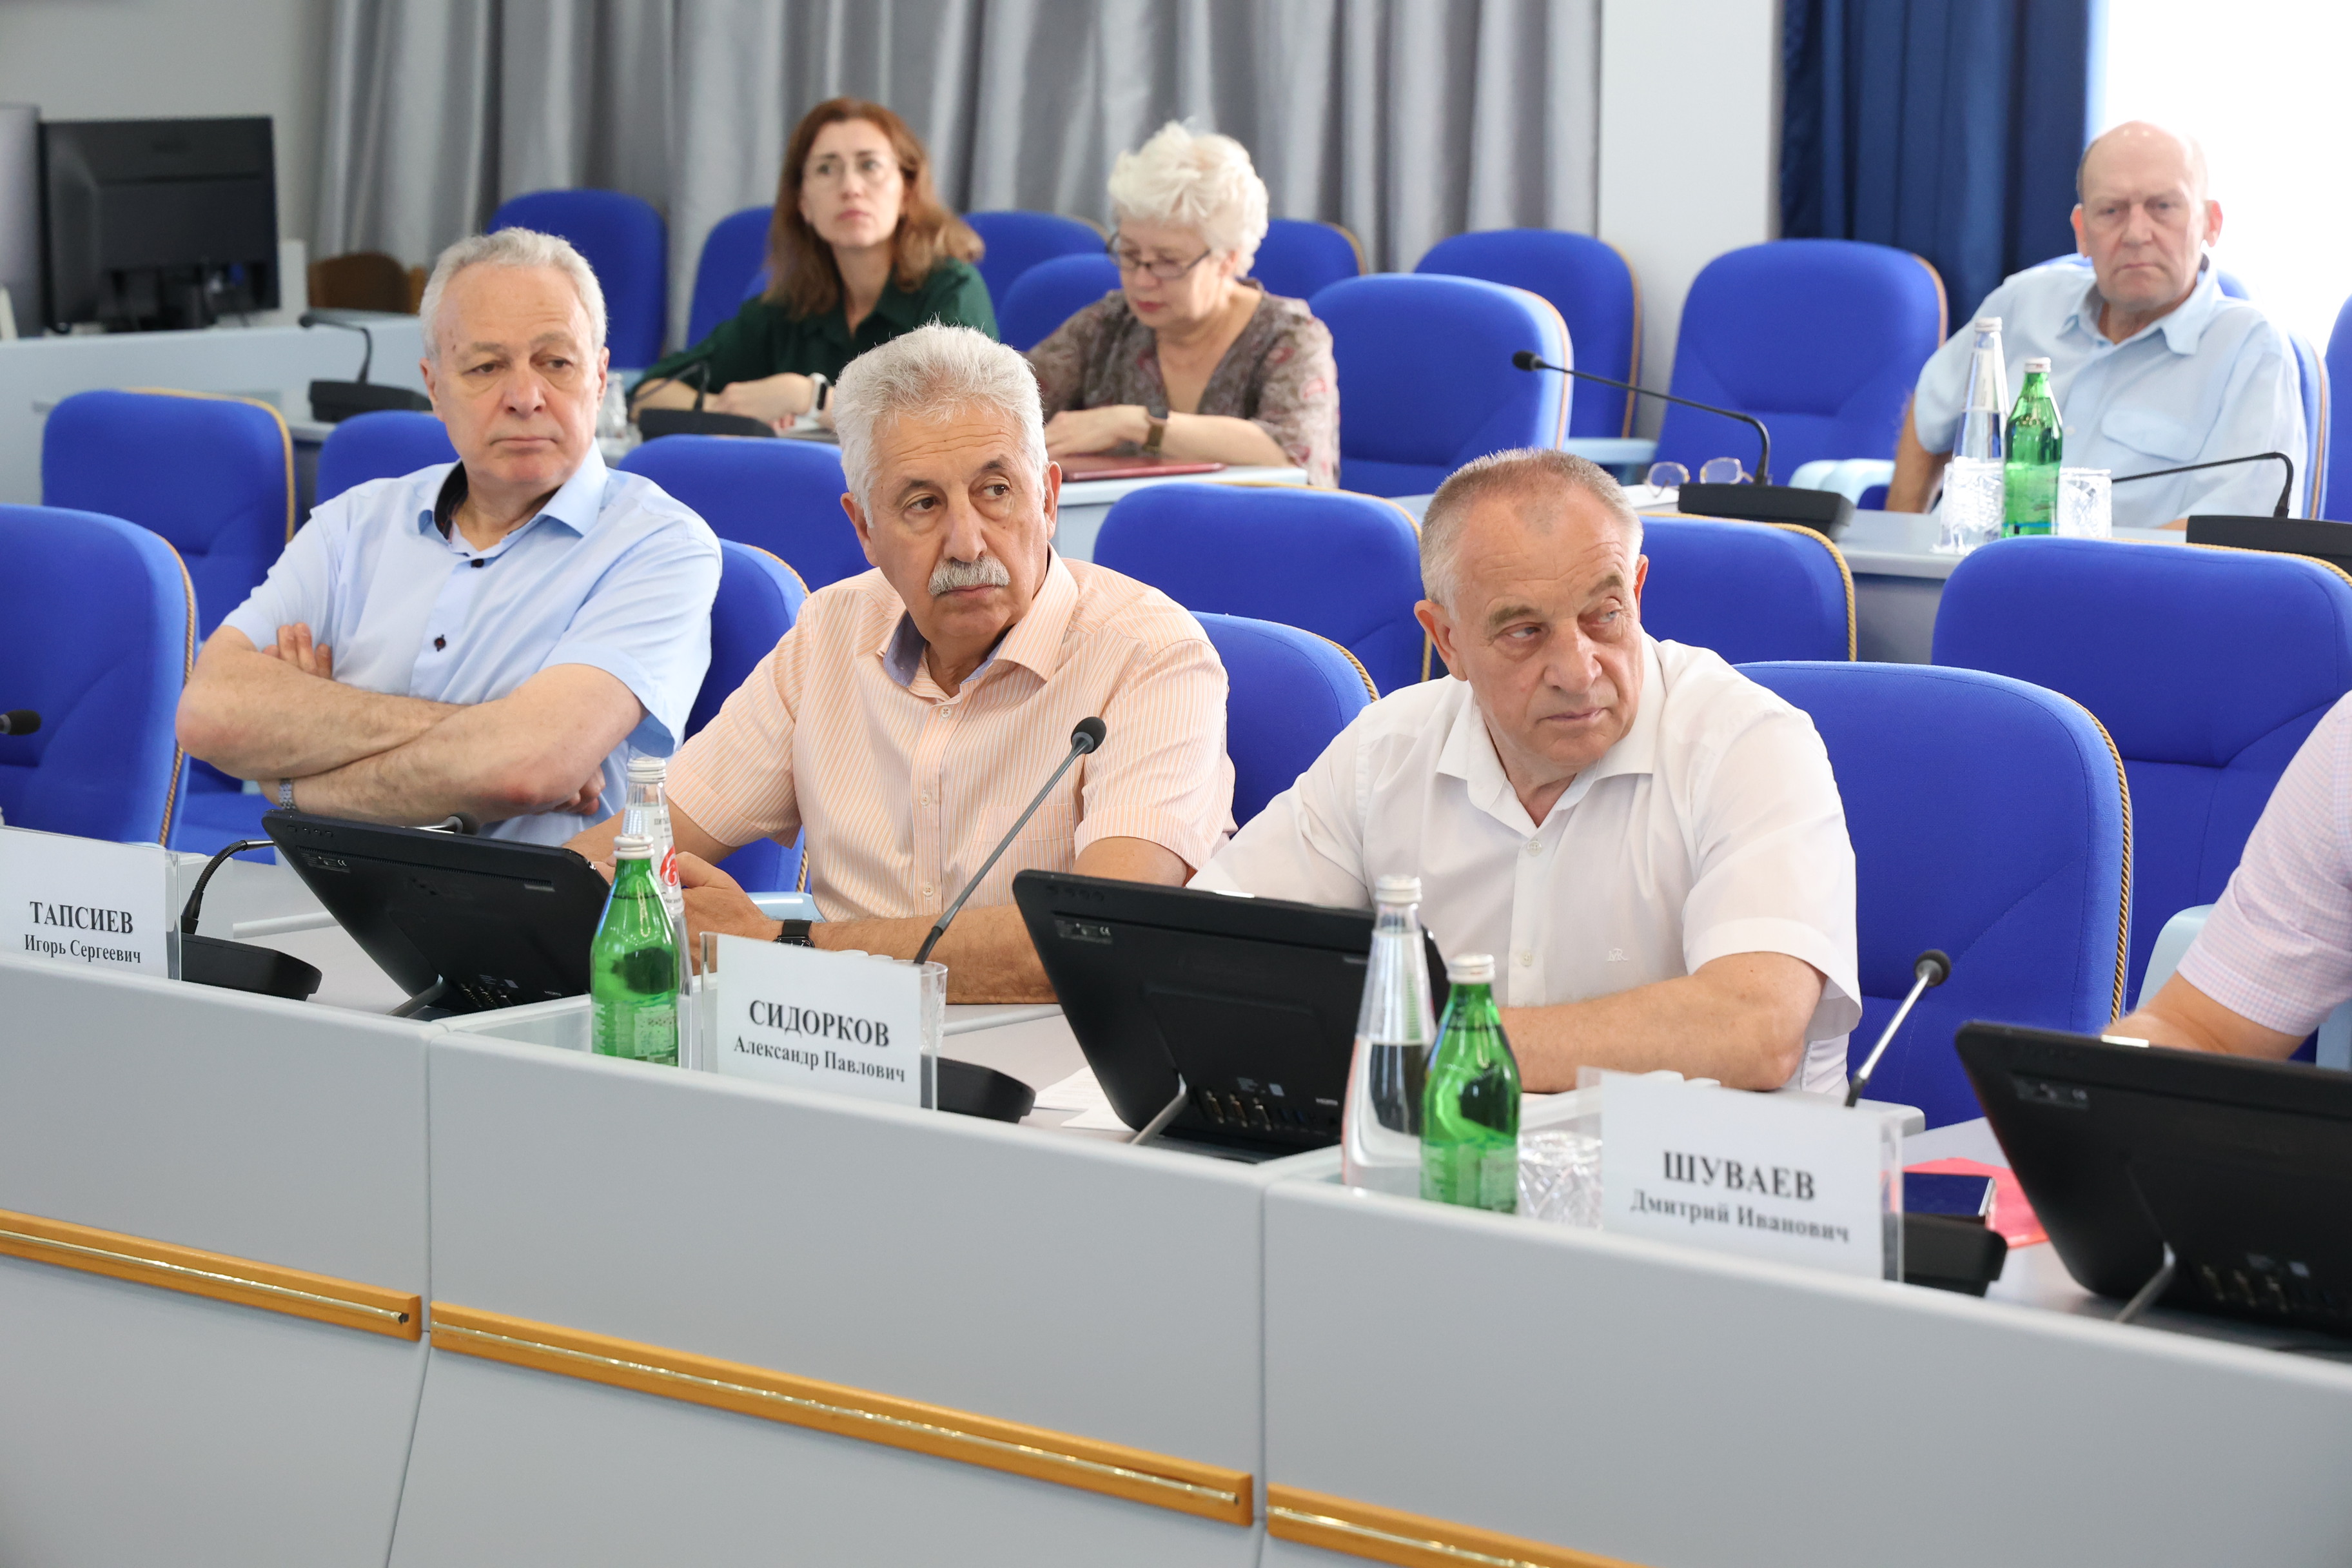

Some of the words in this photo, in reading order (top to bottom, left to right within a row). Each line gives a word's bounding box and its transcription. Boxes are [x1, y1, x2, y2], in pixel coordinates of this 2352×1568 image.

[29, 901, 133, 934] ТАПСИЕВ
[24, 934, 66, 958] Игорь
[70, 939, 141, 963] Сергеевич
[749, 999, 890, 1048] СИДОРКОВ
[734, 1035, 819, 1071] Александр
[824, 1050, 905, 1083] Павлович
[1663, 1150, 1815, 1201] ШУВАЕВ
[1629, 1189, 1730, 1224] Дмитрий
[1736, 1204, 1850, 1243] Иванович
